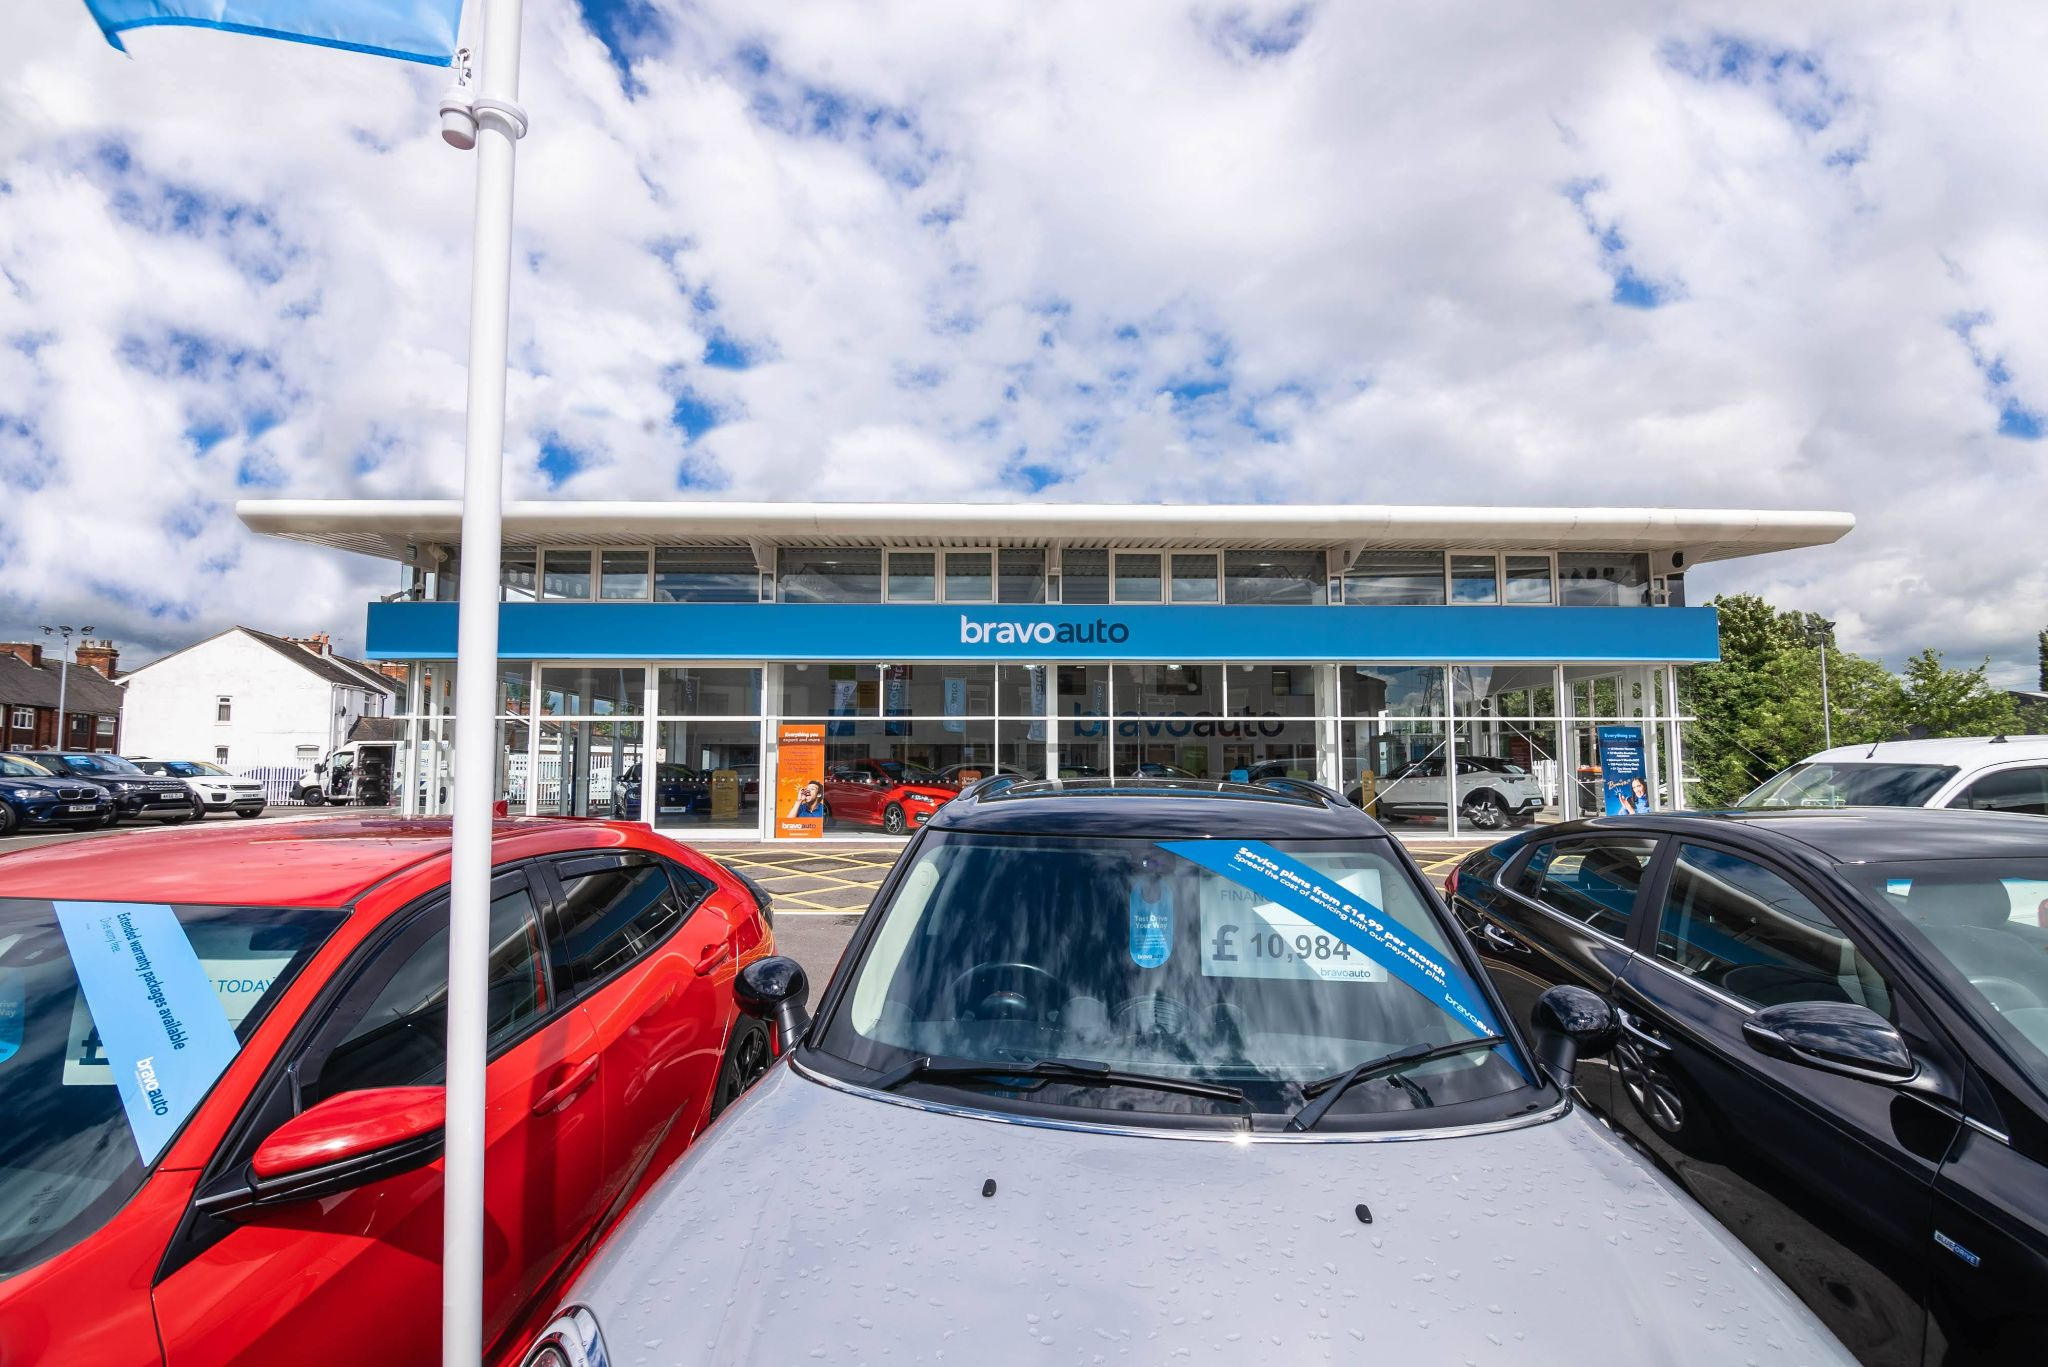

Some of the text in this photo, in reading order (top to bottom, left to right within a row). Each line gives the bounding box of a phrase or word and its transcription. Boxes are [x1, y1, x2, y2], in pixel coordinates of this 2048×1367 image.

[960, 614, 1129, 644] bravoauto
[1074, 702, 1285, 737] bravoauto
[1220, 889, 1264, 902] FINAN
[1238, 846, 1446, 977] Service plans from £14.99 per month
[1149, 914, 1168, 922] Drive
[1152, 922, 1168, 930] Way
[1234, 853, 1265, 872] Spread
[1265, 869, 1280, 880] the
[1280, 878, 1299, 892] cost
[1299, 889, 1311, 897] of
[1309, 894, 1348, 921] servicing
[1349, 917, 1368, 932] with
[1368, 931, 1386, 942] our
[1384, 941, 1425, 971] payment
[1425, 969, 1448, 988] plan.
[1212, 924, 1351, 963] £ 10,984
[117, 911, 189, 1050] Extended warranty packages available
[1320, 967, 1371, 978] bravoauto
[1444, 992, 1496, 1037] bravoaut
[136, 1056, 169, 1116] bravoauto
[1954, 1245, 1977, 1265] DRIVE
